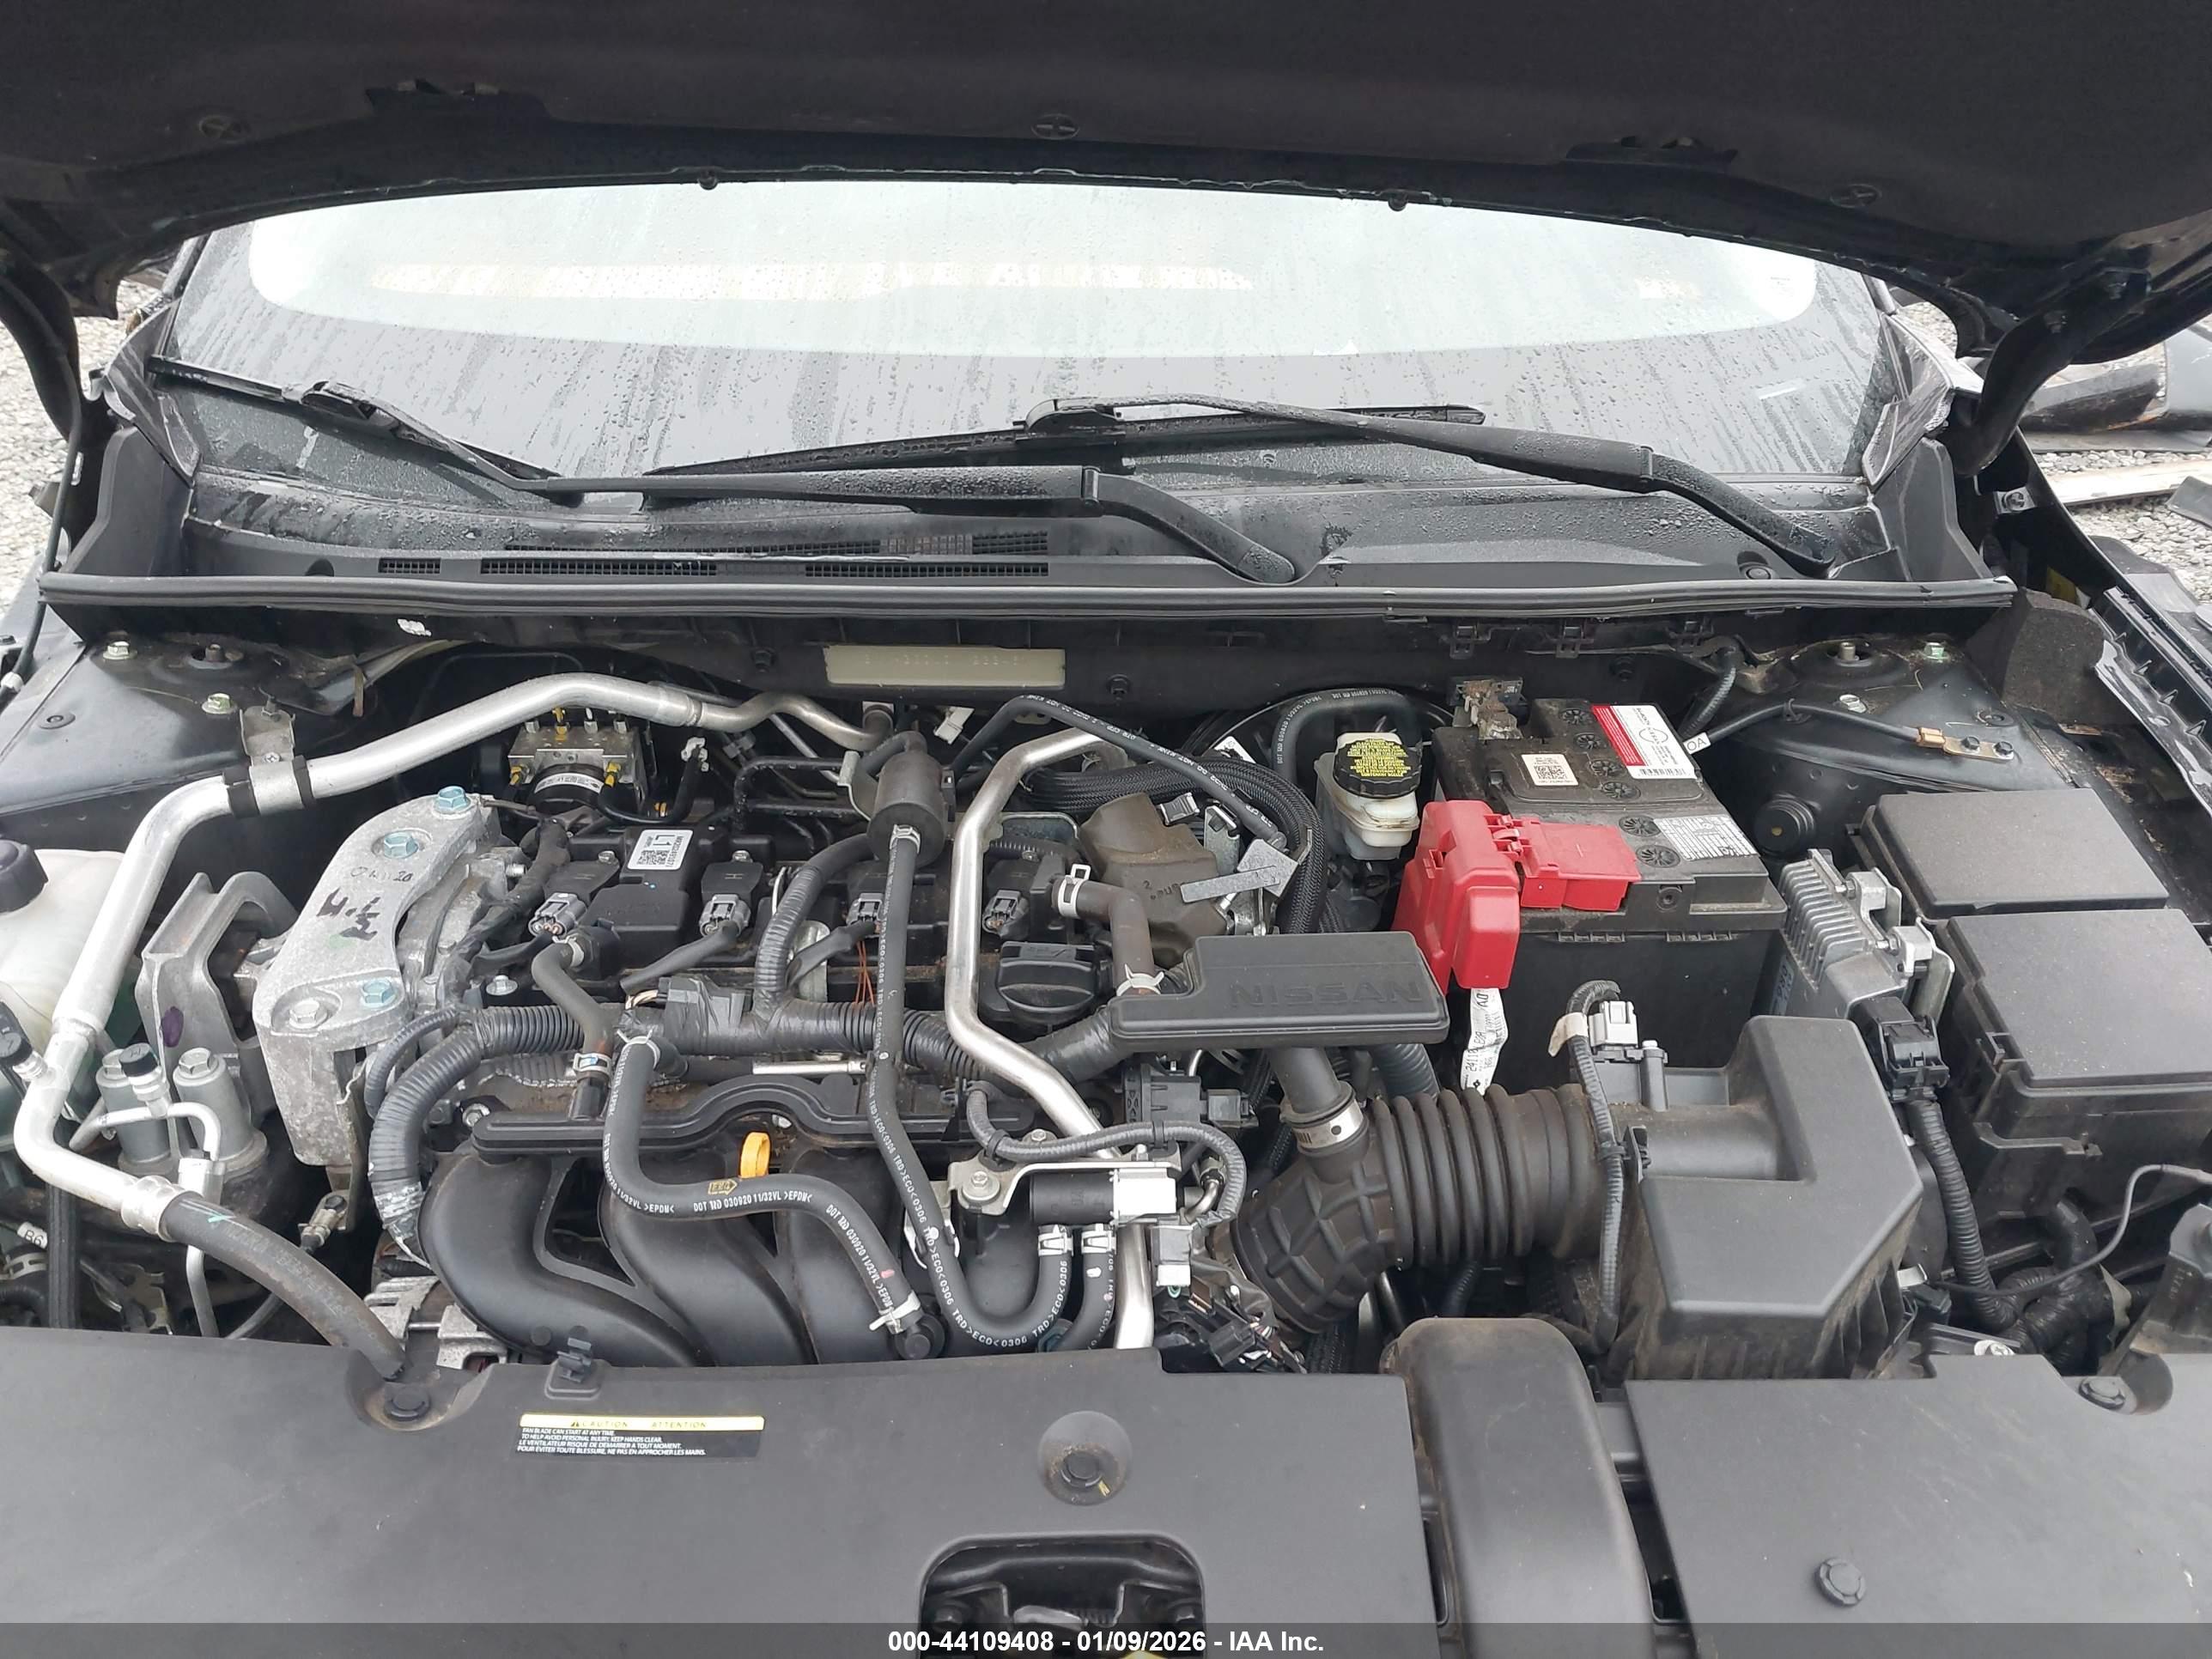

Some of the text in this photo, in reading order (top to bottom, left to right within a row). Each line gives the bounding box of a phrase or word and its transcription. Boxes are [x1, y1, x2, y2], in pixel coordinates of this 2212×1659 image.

[1178, 755, 1195, 767] NOT
[1229, 981, 1422, 1008] NISSAN
[693, 1200, 708, 1212] DOT
[724, 1195, 752, 1209] 030920
[825, 1204, 841, 1220] DOT
[846, 1229, 866, 1257] 030920
[650, 1420, 708, 1429] ATTENTION
